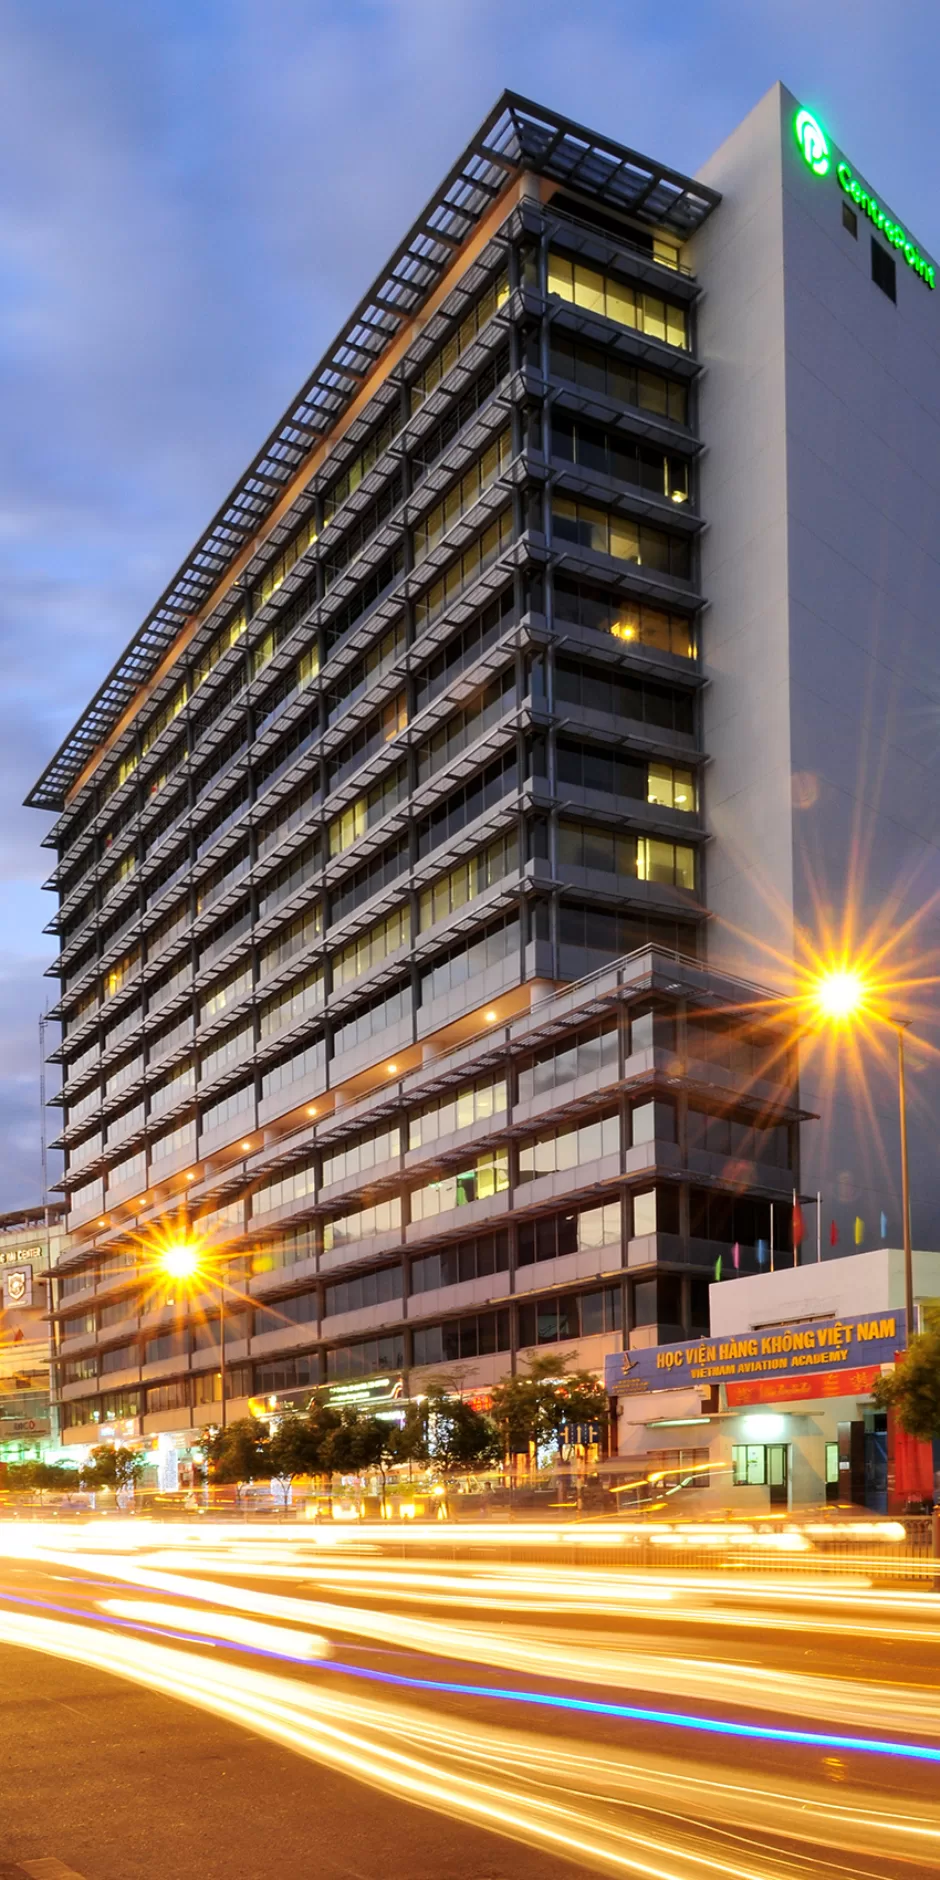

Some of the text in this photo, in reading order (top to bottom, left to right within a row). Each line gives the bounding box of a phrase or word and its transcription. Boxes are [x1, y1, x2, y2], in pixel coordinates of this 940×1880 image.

[836, 161, 937, 289] CentrePoint
[17, 1247, 42, 1261] CENTER
[656, 1317, 896, 1371] HỌC VIỆN HÀNG KHÔNG VIỆT NAM
[691, 1349, 849, 1378] VIETNAM AVIATION ACADEMY
